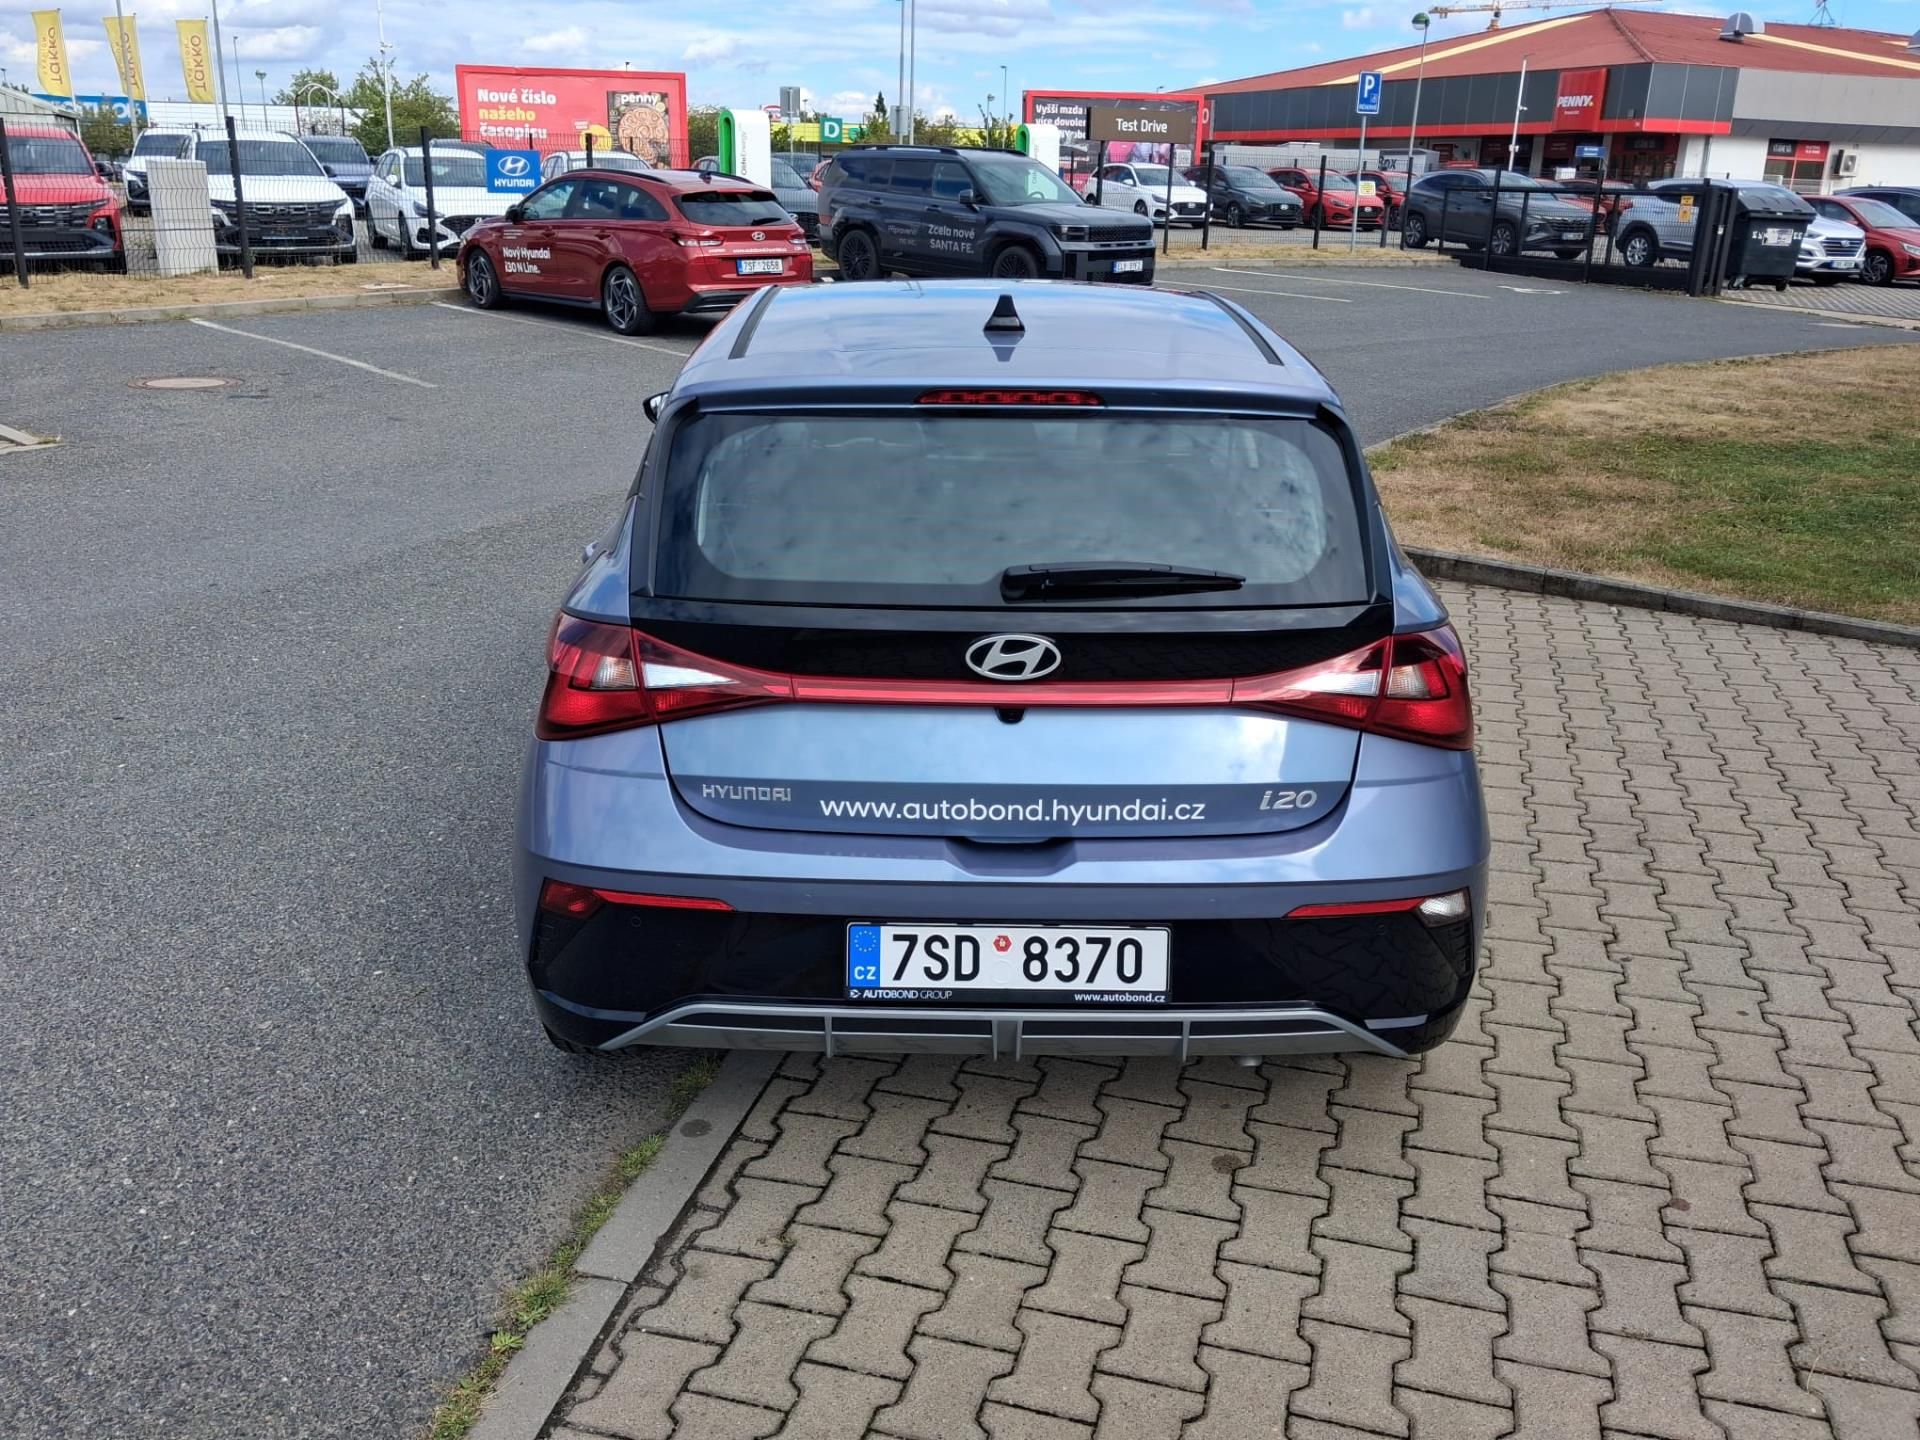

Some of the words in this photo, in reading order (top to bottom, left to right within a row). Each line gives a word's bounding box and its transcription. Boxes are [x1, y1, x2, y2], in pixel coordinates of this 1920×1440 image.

[1364, 75, 1376, 98] P
[477, 88, 518, 105] Nové
[521, 89, 557, 105] číslo
[620, 93, 660, 106] penny
[478, 106, 536, 121] našeho
[1035, 103, 1058, 116] Vyšší
[1060, 105, 1083, 115] mzda
[823, 121, 841, 138] D
[1115, 118, 1138, 133] Test
[1141, 119, 1168, 133] Drive
[494, 178, 535, 188] HYUNDAI
[928, 224, 952, 237] Zcela
[953, 227, 976, 239] nové
[502, 246, 520, 260] Nový
[521, 247, 551, 260] Hyundai
[929, 238, 960, 252] SANTA
[960, 243, 975, 254] FE.
[504, 261, 517, 273] i30
[518, 262, 525, 273] N
[525, 262, 541, 274] Line.
[702, 783, 792, 802] HYUNDAI
[1259, 789, 1318, 811] i20
[820, 798, 1206, 826] www.autobond.hyundai.cz
[891, 933, 980, 982] 7SD
[1022, 935, 1143, 984] 8370
[854, 965, 877, 981] CZ
[862, 989, 919, 999] AUTOBOND
[919, 990, 953, 1000] GROUP
[1074, 992, 1166, 1004] www.autobond.cz
